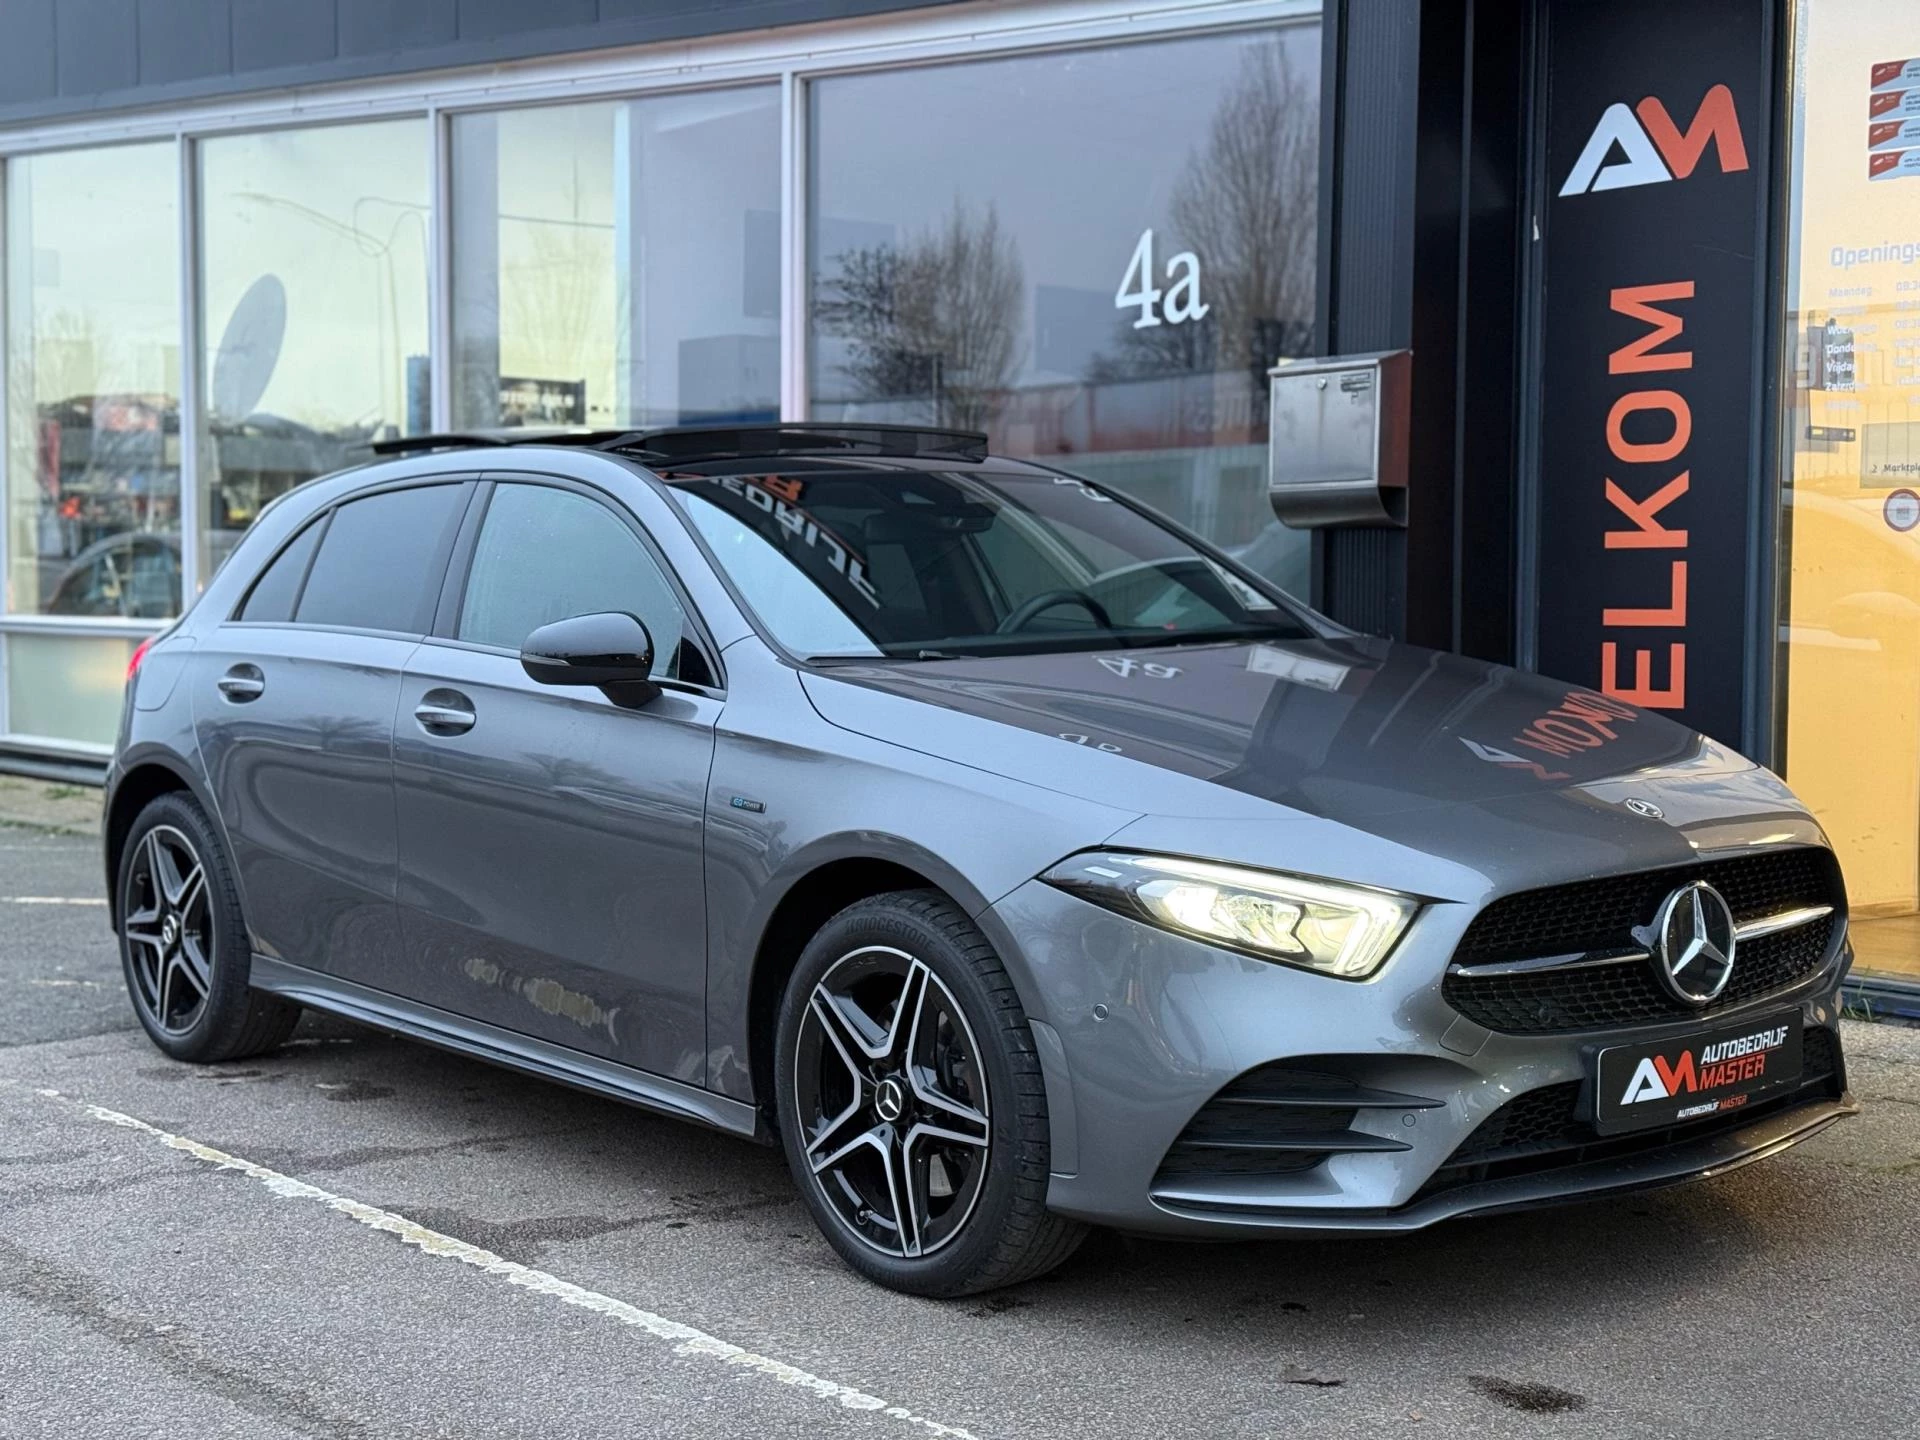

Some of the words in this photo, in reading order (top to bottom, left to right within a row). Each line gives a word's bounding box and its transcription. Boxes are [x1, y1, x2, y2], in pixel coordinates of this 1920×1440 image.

[1558, 84, 1749, 197] AM
[1115, 228, 1210, 329] 4a
[1700, 1026, 1789, 1065] AUTOBEDRIJF
[1620, 1050, 1698, 1105] AM
[1700, 1054, 1766, 1090] MASTER
[1677, 1101, 1720, 1119] AUTOBEDRIJF
[1719, 1094, 1748, 1110] MASTER
